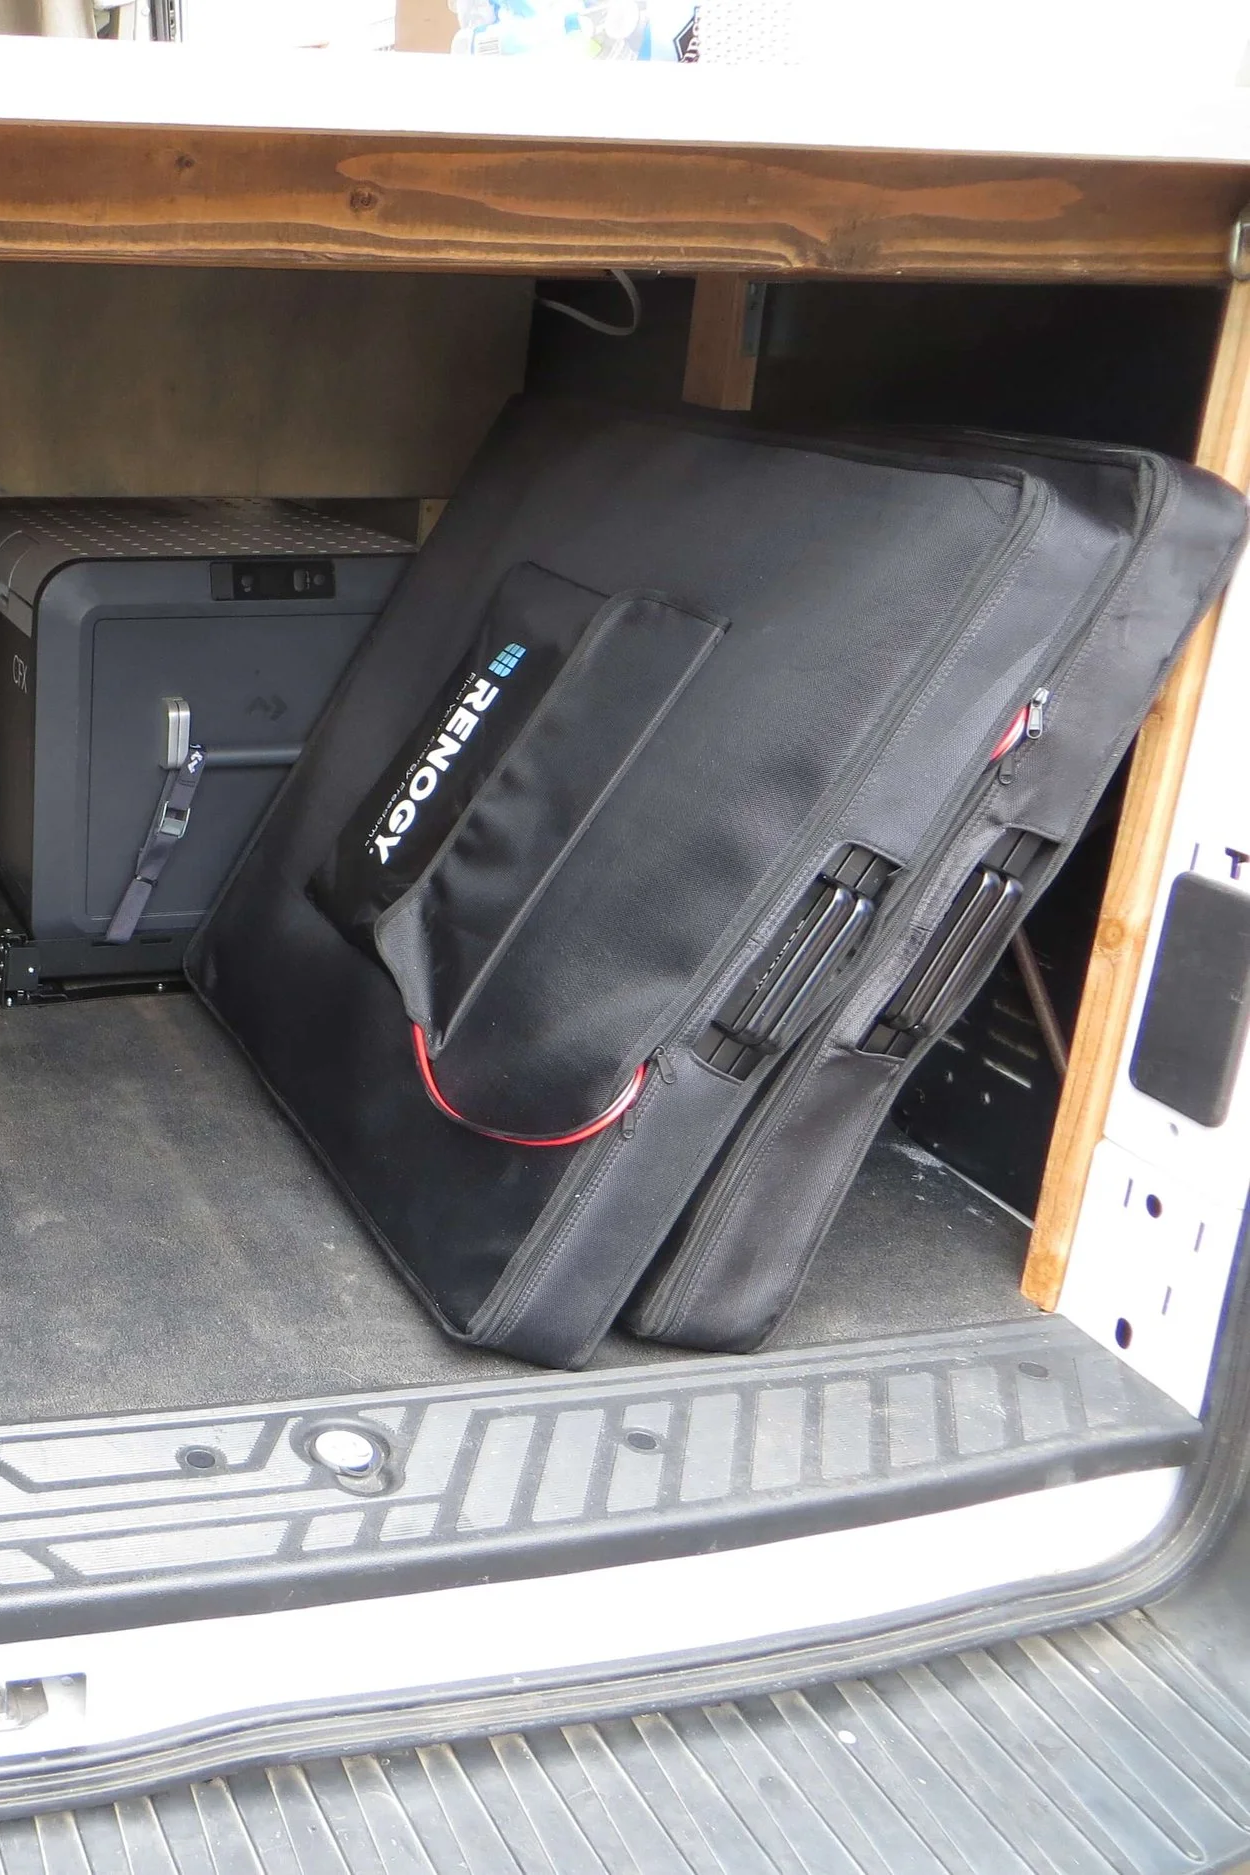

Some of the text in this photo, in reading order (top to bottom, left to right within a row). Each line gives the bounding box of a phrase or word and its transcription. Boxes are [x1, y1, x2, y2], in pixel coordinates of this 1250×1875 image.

[12, 654, 28, 694] CFX
[456, 671, 477, 699] Find
[374, 678, 500, 865] RENOGY
[406, 735, 437, 779] Energy
[367, 782, 406, 837] Freedom
